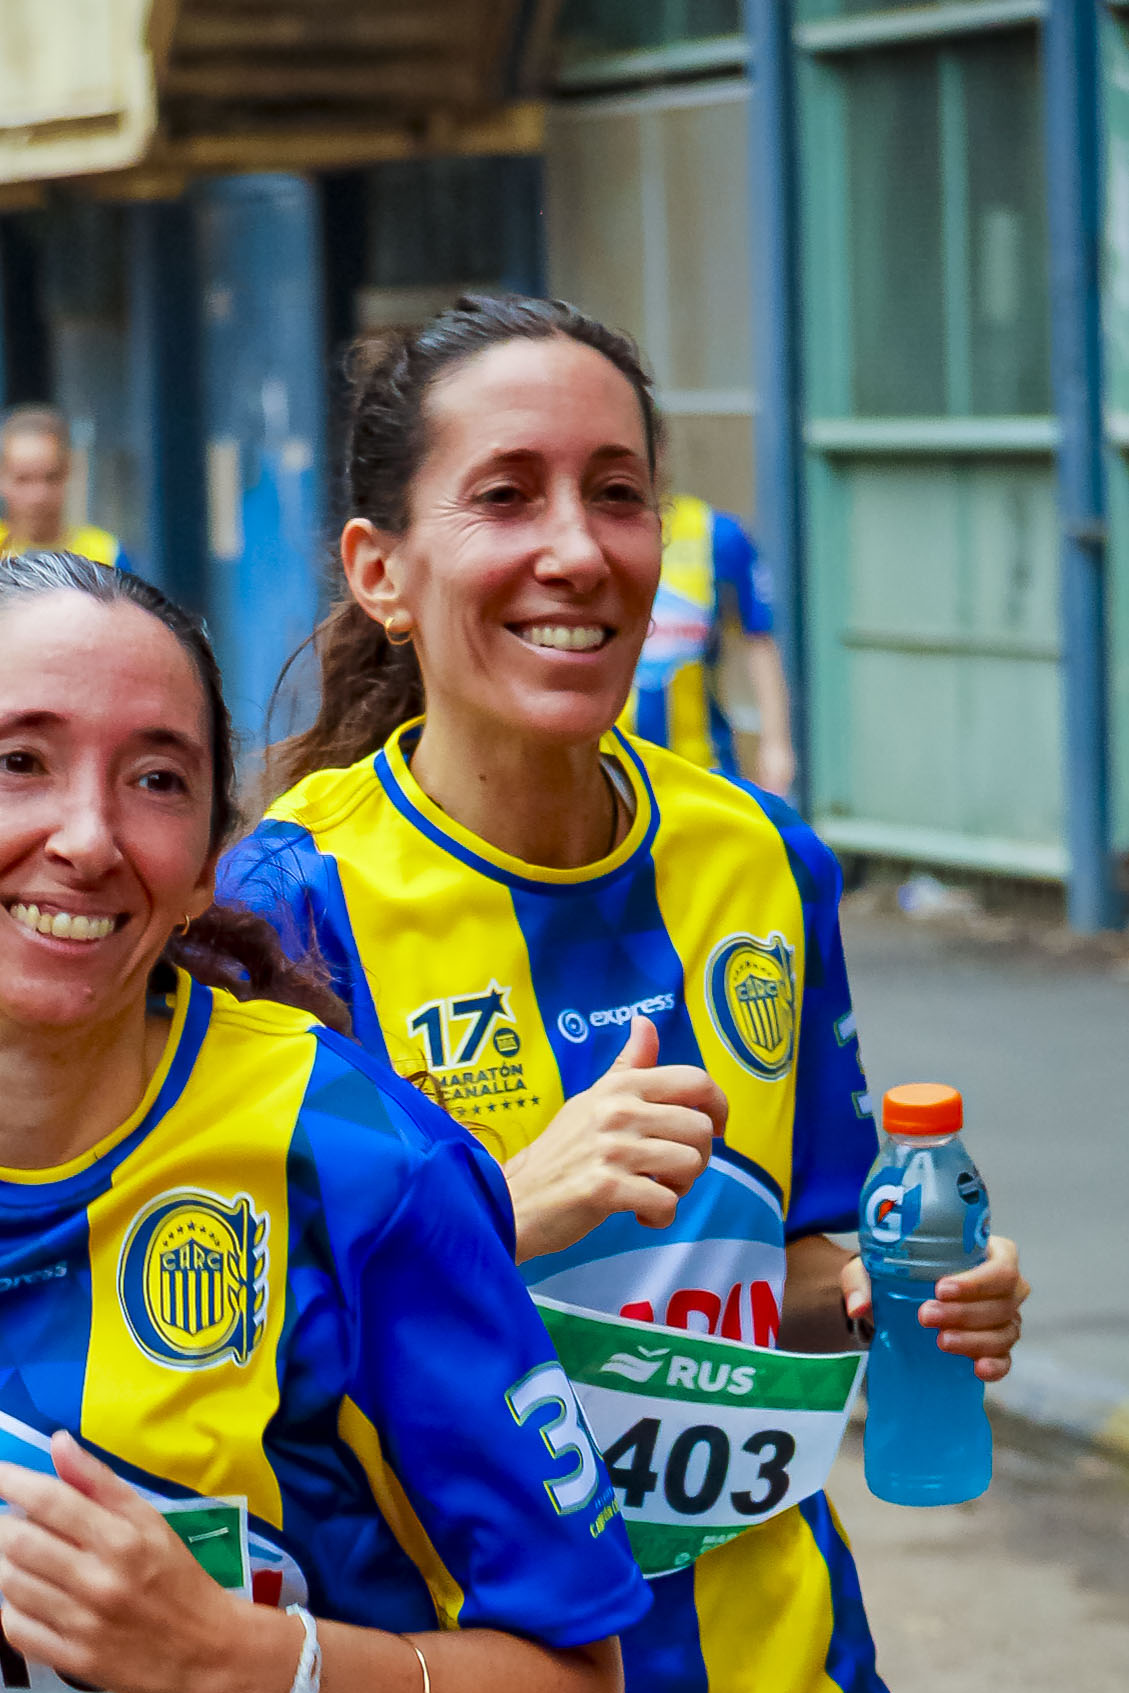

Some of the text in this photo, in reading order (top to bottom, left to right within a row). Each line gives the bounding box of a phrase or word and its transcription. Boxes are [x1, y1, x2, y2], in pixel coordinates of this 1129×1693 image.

[407, 980, 516, 1071] 17
[589, 993, 674, 1026] express
[162, 1245, 221, 1272] CARC
[666, 1355, 756, 1396] RUS
[602, 1416, 796, 1515] 403
